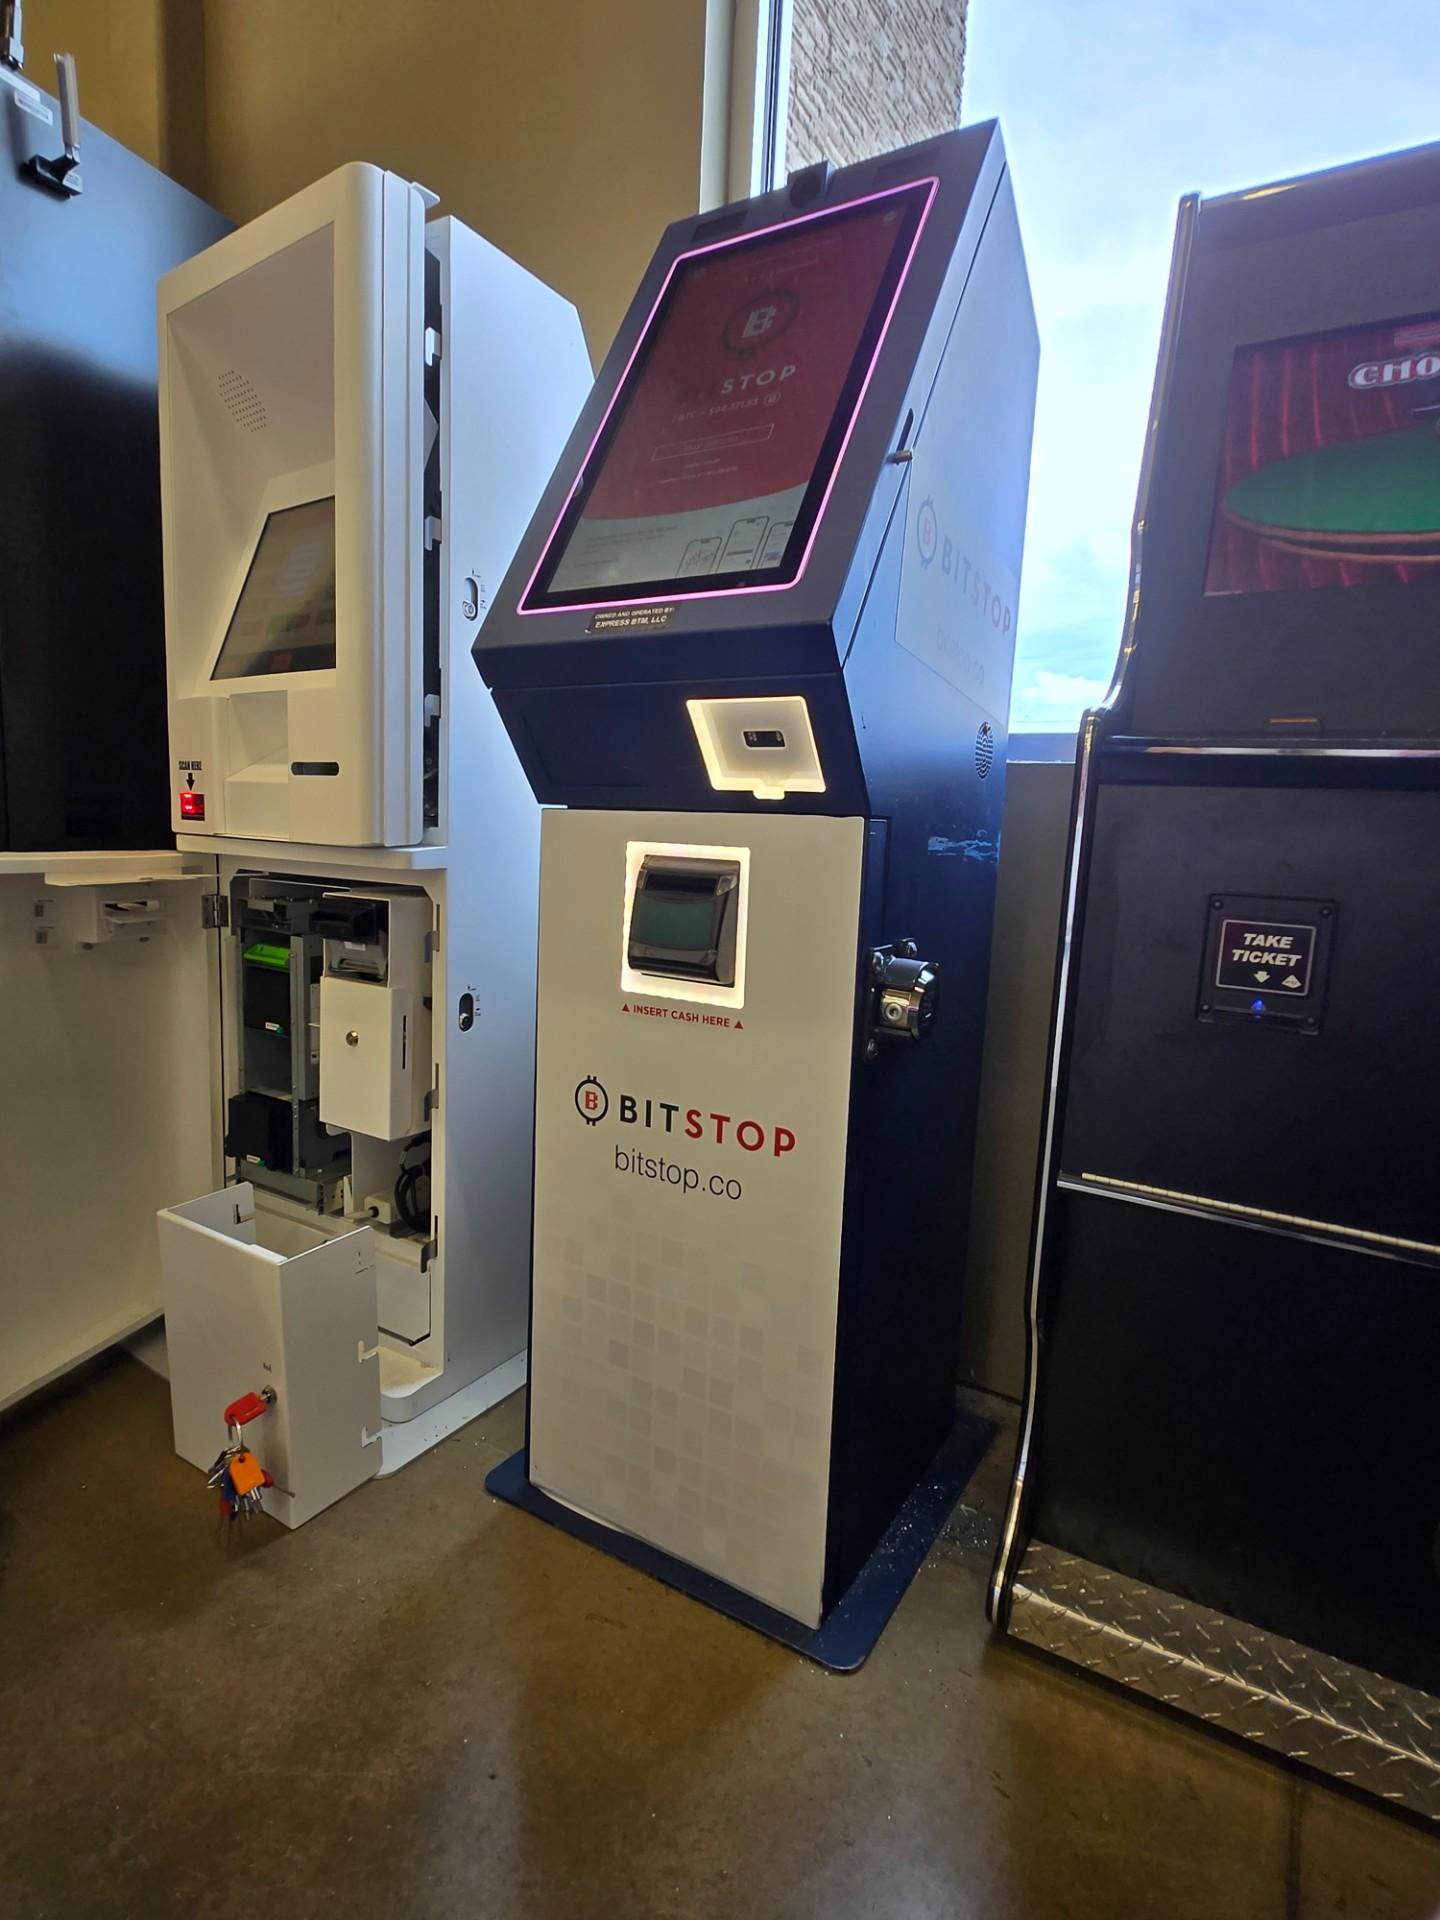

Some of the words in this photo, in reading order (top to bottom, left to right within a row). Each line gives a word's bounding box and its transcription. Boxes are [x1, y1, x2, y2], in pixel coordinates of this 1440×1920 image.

[942, 535, 1011, 636] BITSTOP
[631, 608, 663, 616] OPERATED
[595, 618, 630, 628] EXPRESS
[651, 615, 667, 623] LLC
[179, 760, 191, 771] SCAN
[191, 760, 202, 771] HERE
[1243, 933, 1294, 949] TAKE
[1232, 949, 1302, 967] TICKET
[633, 1004, 669, 1018] INSERT
[671, 1010, 700, 1023] CASH
[702, 1015, 731, 1028] HERE
[619, 1094, 796, 1157] BITSTOP
[615, 1144, 742, 1200] bitstop.co
